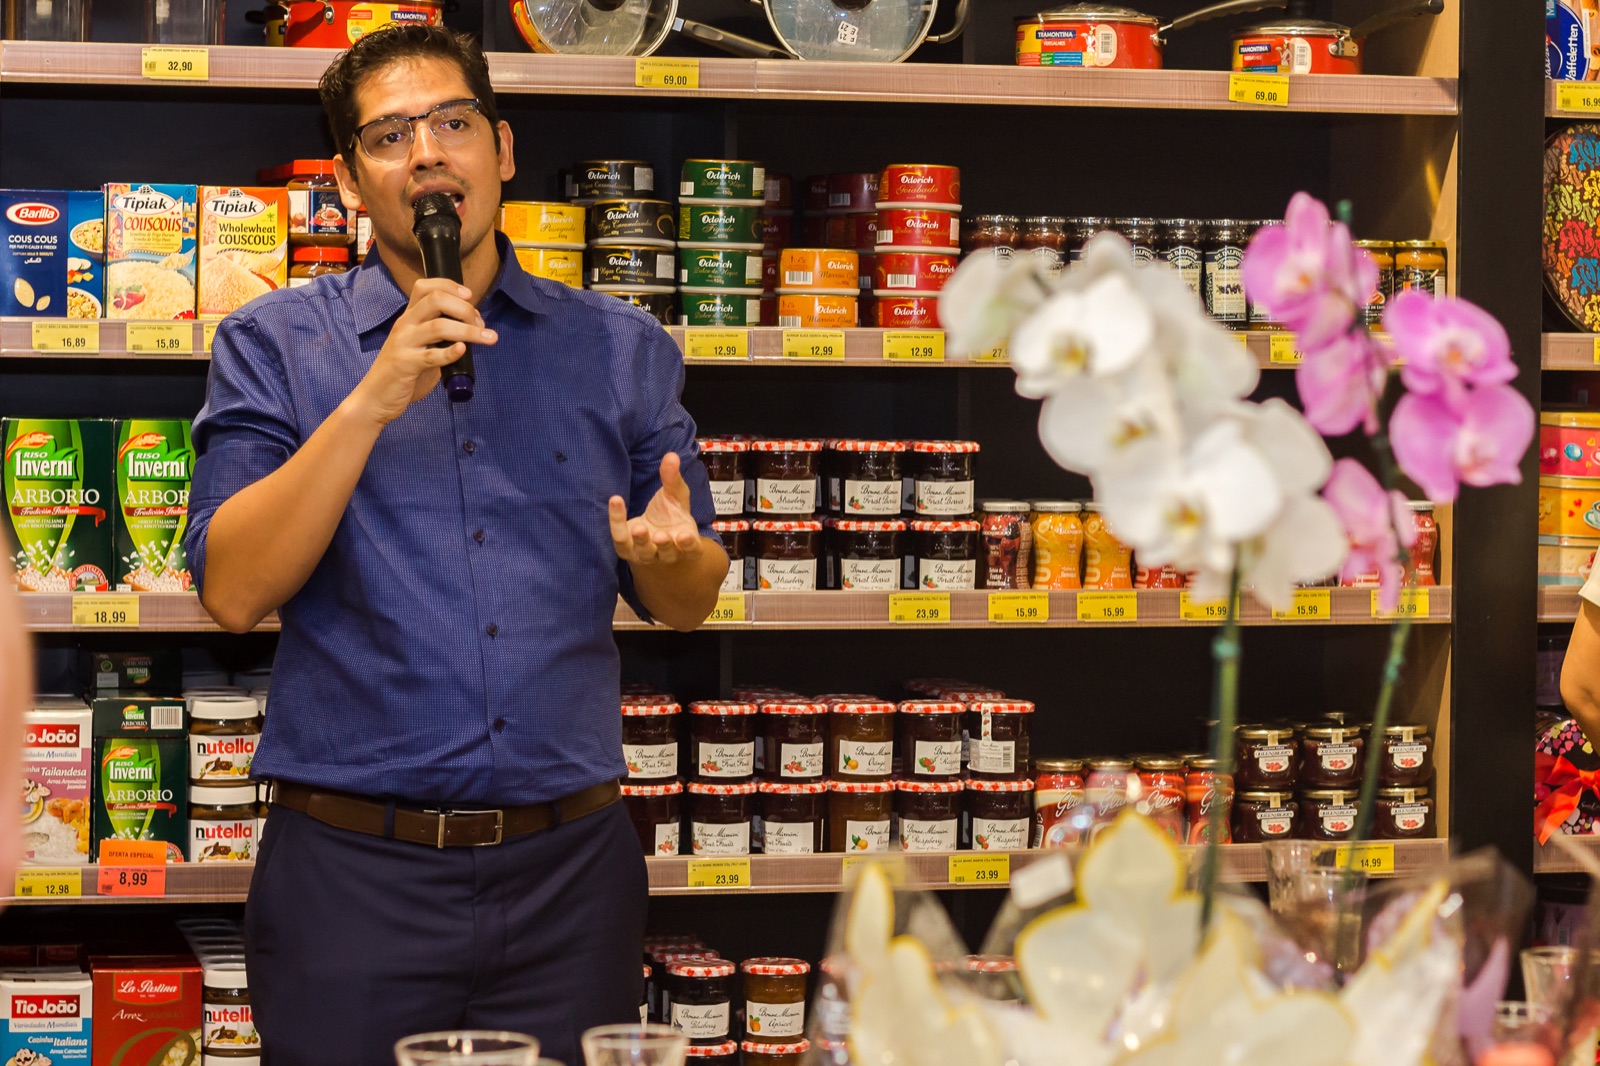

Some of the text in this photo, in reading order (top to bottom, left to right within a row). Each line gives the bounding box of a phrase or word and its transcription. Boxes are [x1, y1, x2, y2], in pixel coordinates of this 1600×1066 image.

[1037, 31, 1073, 39] TRAMONTINA
[1240, 46, 1269, 54] TRAMONTINA
[167, 60, 193, 72] 32,90
[663, 75, 688, 86] 69,00
[1255, 90, 1278, 102] 69,00
[587, 170, 621, 180] Odorich
[706, 171, 741, 180] Odorich
[901, 174, 934, 185] Odorich
[895, 184, 939, 196] Goiabada
[122, 195, 168, 211] Tipiak
[211, 198, 258, 214] Tipiak
[18, 207, 55, 220] Barilla
[541, 215, 574, 224] Odorich
[607, 211, 640, 221] Odorich
[702, 215, 736, 224] Odorich
[540, 224, 576, 234] Pessegada
[906, 219, 939, 229] Odorich
[219, 223, 277, 238] Wholewheat
[8, 234, 58, 244] COUS COUS
[219, 237, 277, 251] COUSCOUS
[548, 261, 577, 270] Odorich
[609, 256, 643, 268] Odorich
[699, 258, 733, 269] Odorich
[828, 260, 854, 270] Odorich
[699, 303, 733, 313] Odorich
[816, 304, 847, 315] Odorich
[893, 306, 927, 317] Odorich
[889, 316, 931, 327] Goiabada
[62, 337, 86, 348] 16,89
[155, 338, 180, 349] 15,89
[713, 346, 737, 357] 12,99
[810, 346, 833, 357] 12,99
[910, 347, 933, 358] 12,99
[23, 451, 48, 460] RISO
[136, 452, 161, 461] RISO
[15, 451, 73, 479] Inverni
[128, 451, 186, 479] Inverni
[769, 482, 787, 495] Bonne
[860, 482, 880, 496] Bonne
[924, 483, 943, 496] Bonne
[11, 488, 100, 505] ARBORIO
[124, 488, 188, 505] ARBOR
[767, 562, 786, 575] Bonne
[850, 562, 868, 576] Bonne
[934, 563, 953, 576] Bonne
[711, 609, 734, 619] 23,99
[916, 608, 939, 619] 23,99
[1015, 607, 1038, 618] 15,99
[1102, 607, 1125, 618] 15,99
[1205, 606, 1227, 617] 15,99
[1296, 605, 1318, 616] 15,99
[1396, 603, 1417, 615] 15,99
[94, 610, 126, 624] 18,99
[125, 711, 145, 721] Inverni
[37, 728, 77, 744] João
[197, 738, 255, 756] nutella
[634, 747, 656, 759] Bonne
[715, 747, 734, 759] Bonne
[800, 747, 817, 759] Bonne
[855, 744, 875, 757] Bonne
[933, 744, 953, 756] Bonne
[41, 766, 88, 778] Tailandesa
[109, 760, 154, 781] Inverni
[106, 789, 174, 802] ARBORIO
[1144, 789, 1182, 816] Glam
[195, 822, 253, 840] nutella
[697, 827, 714, 838] Bonne
[865, 823, 884, 836] Bonne
[906, 823, 925, 835] Bonne
[987, 823, 1007, 835] Bonne
[108, 850, 155, 860] OFERTA ESPECIAL
[1360, 857, 1382, 868] 14,99
[119, 872, 148, 887] 8,99
[715, 874, 739, 885] 23,99
[975, 869, 999, 880] 23,99
[45, 884, 70, 895] 12,98
[117, 979, 178, 993] La Pastina
[14, 999, 78, 1015] Tio João
[758, 1006, 778, 1018] Bonne
[112, 1009, 148, 1023] Arroz
[681, 1008, 703, 1020] Bonne
[27, 1035, 88, 1047] Cozinha Italiana
